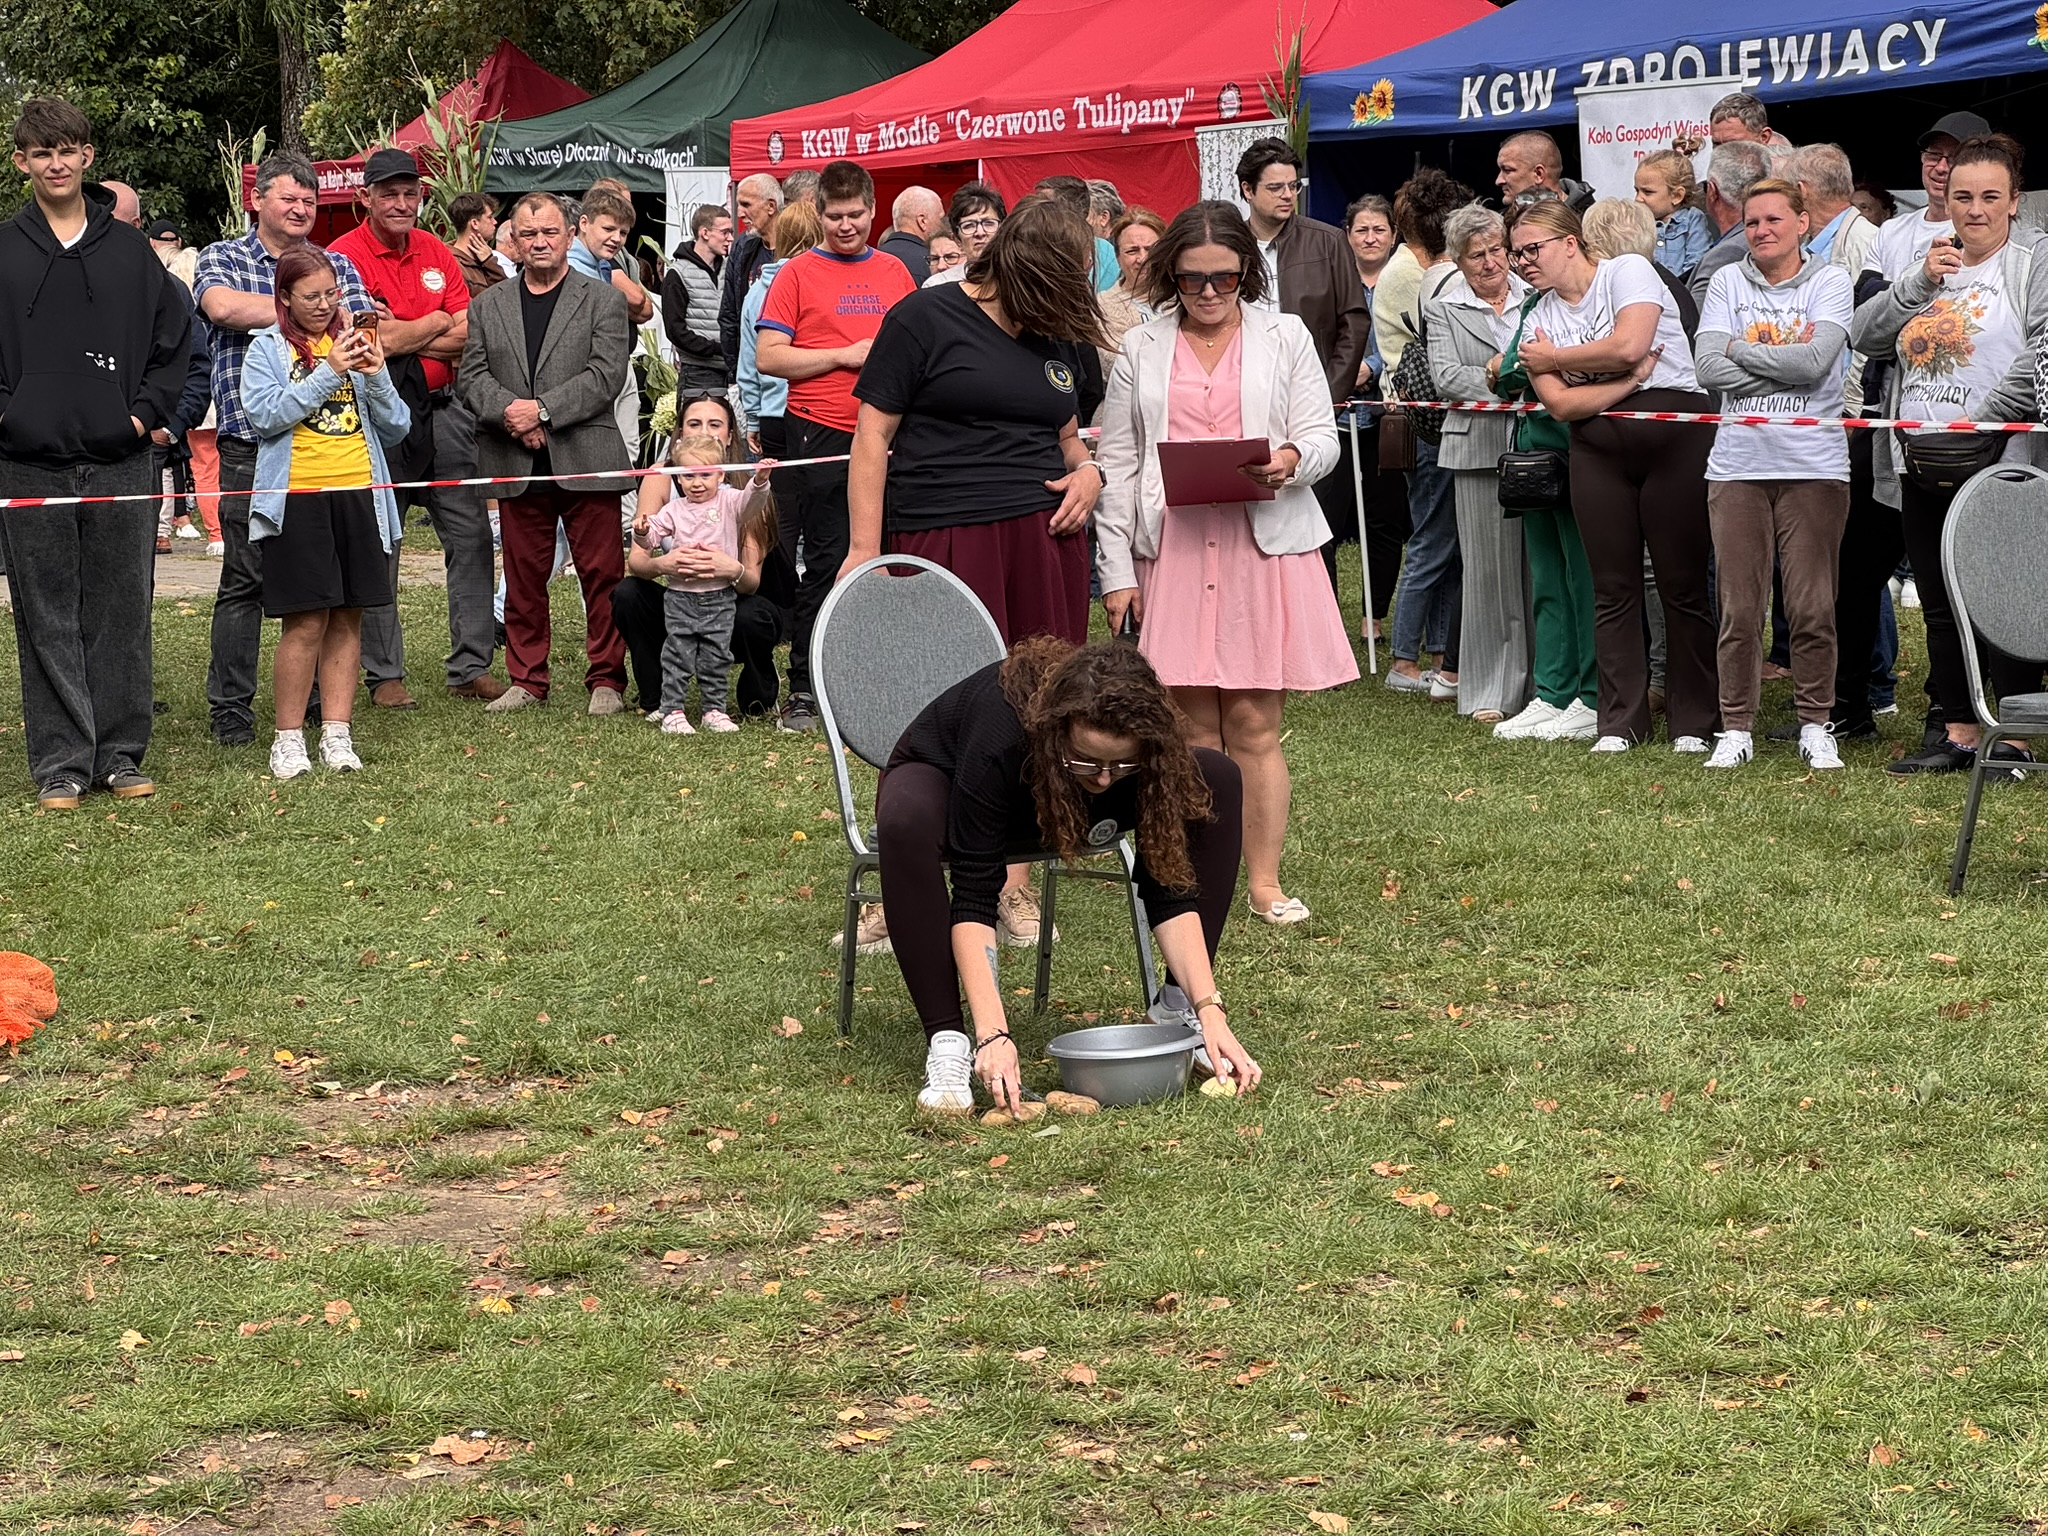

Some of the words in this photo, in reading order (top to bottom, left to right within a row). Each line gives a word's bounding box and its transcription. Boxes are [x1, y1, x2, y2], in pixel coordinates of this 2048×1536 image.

[1458, 68, 1557, 119] KGW
[1576, 18, 1947, 88] ZDROJEWIACY
[801, 126, 850, 158] KGW
[855, 132, 872, 154] w
[946, 106, 1066, 140] "Czerwone
[1072, 87, 1195, 133] Tulipany"
[1587, 125, 1613, 145] Koło
[1615, 120, 1672, 146] Gospodyń
[1673, 119, 1712, 137] Wiejs
[524, 144, 563, 169] Starej
[836, 304, 888, 316] ORIGINALS
[839, 294, 882, 305] DIVERSE
